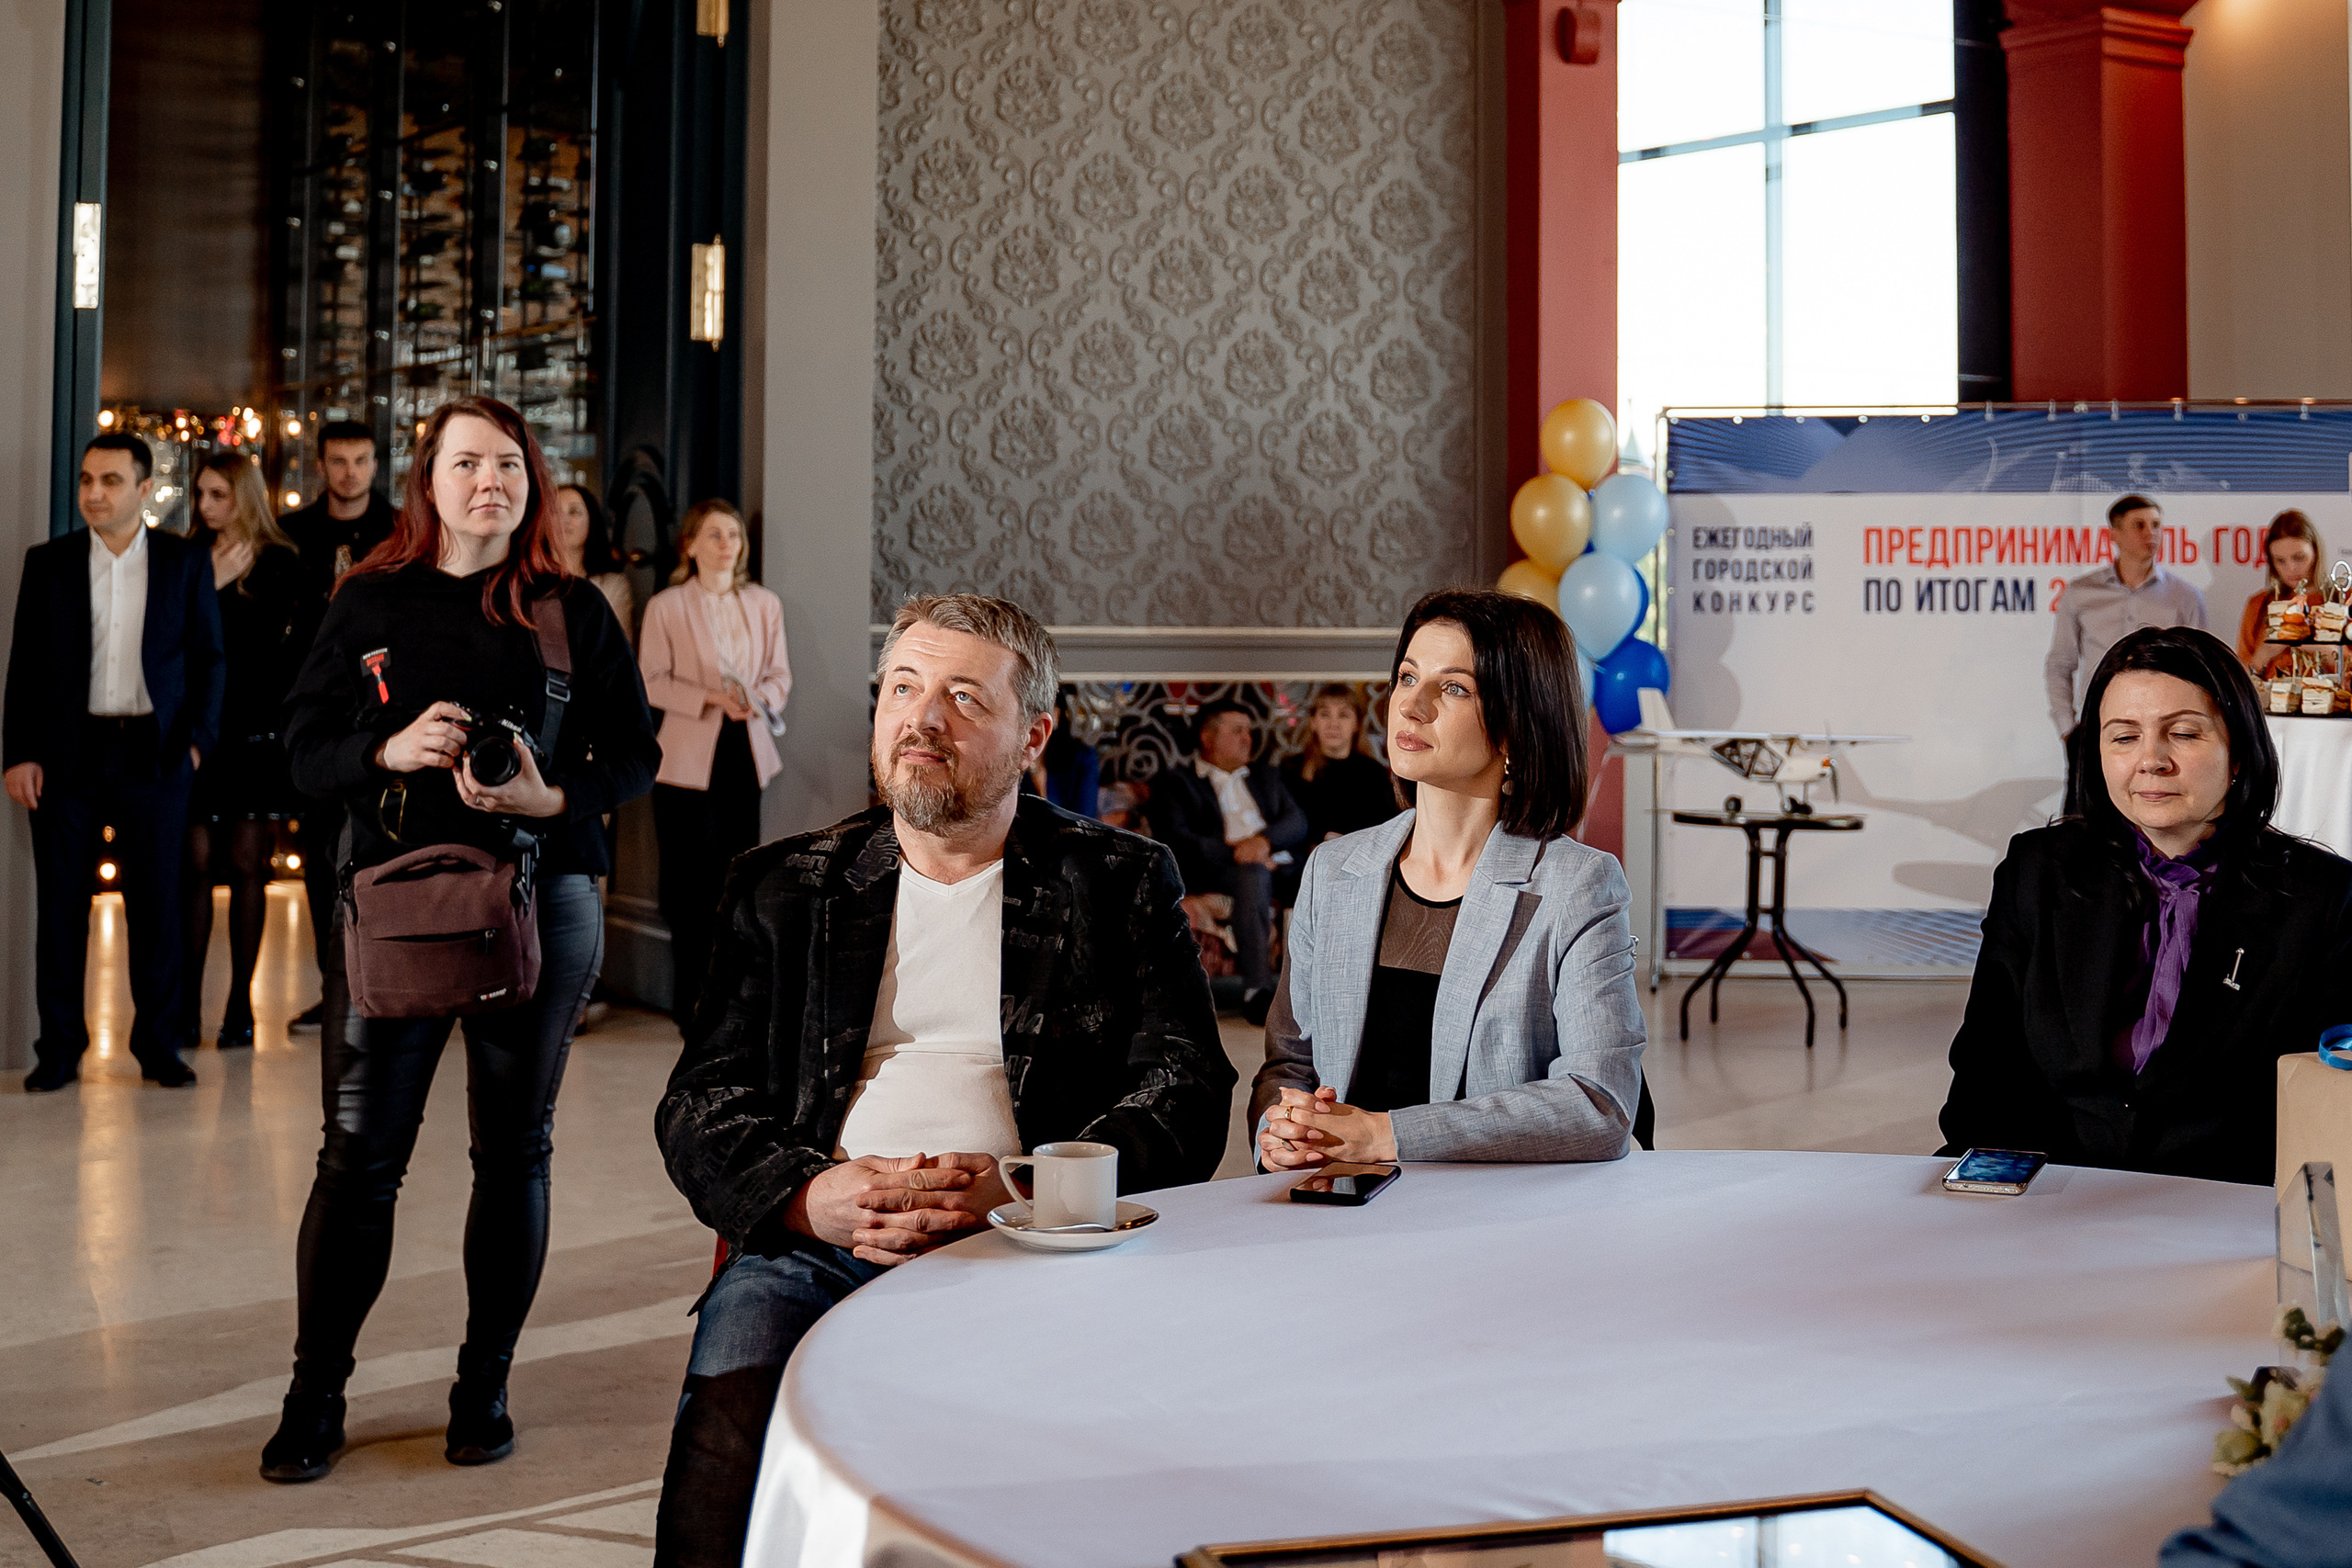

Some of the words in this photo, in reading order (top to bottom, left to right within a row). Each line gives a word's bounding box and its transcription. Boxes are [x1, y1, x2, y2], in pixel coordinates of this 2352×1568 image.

[1692, 522, 1814, 550] ЕЖЕГОДНЫЙ
[1863, 526, 2199, 569] ПРЕДПРИНИМАЛЬ
[1692, 554, 1814, 582] ГОРОДСКОЙ
[1692, 590, 1815, 615] КОНКУРС
[1864, 578, 1902, 613] ПО
[1915, 578, 2036, 613] ИТОГАМ
